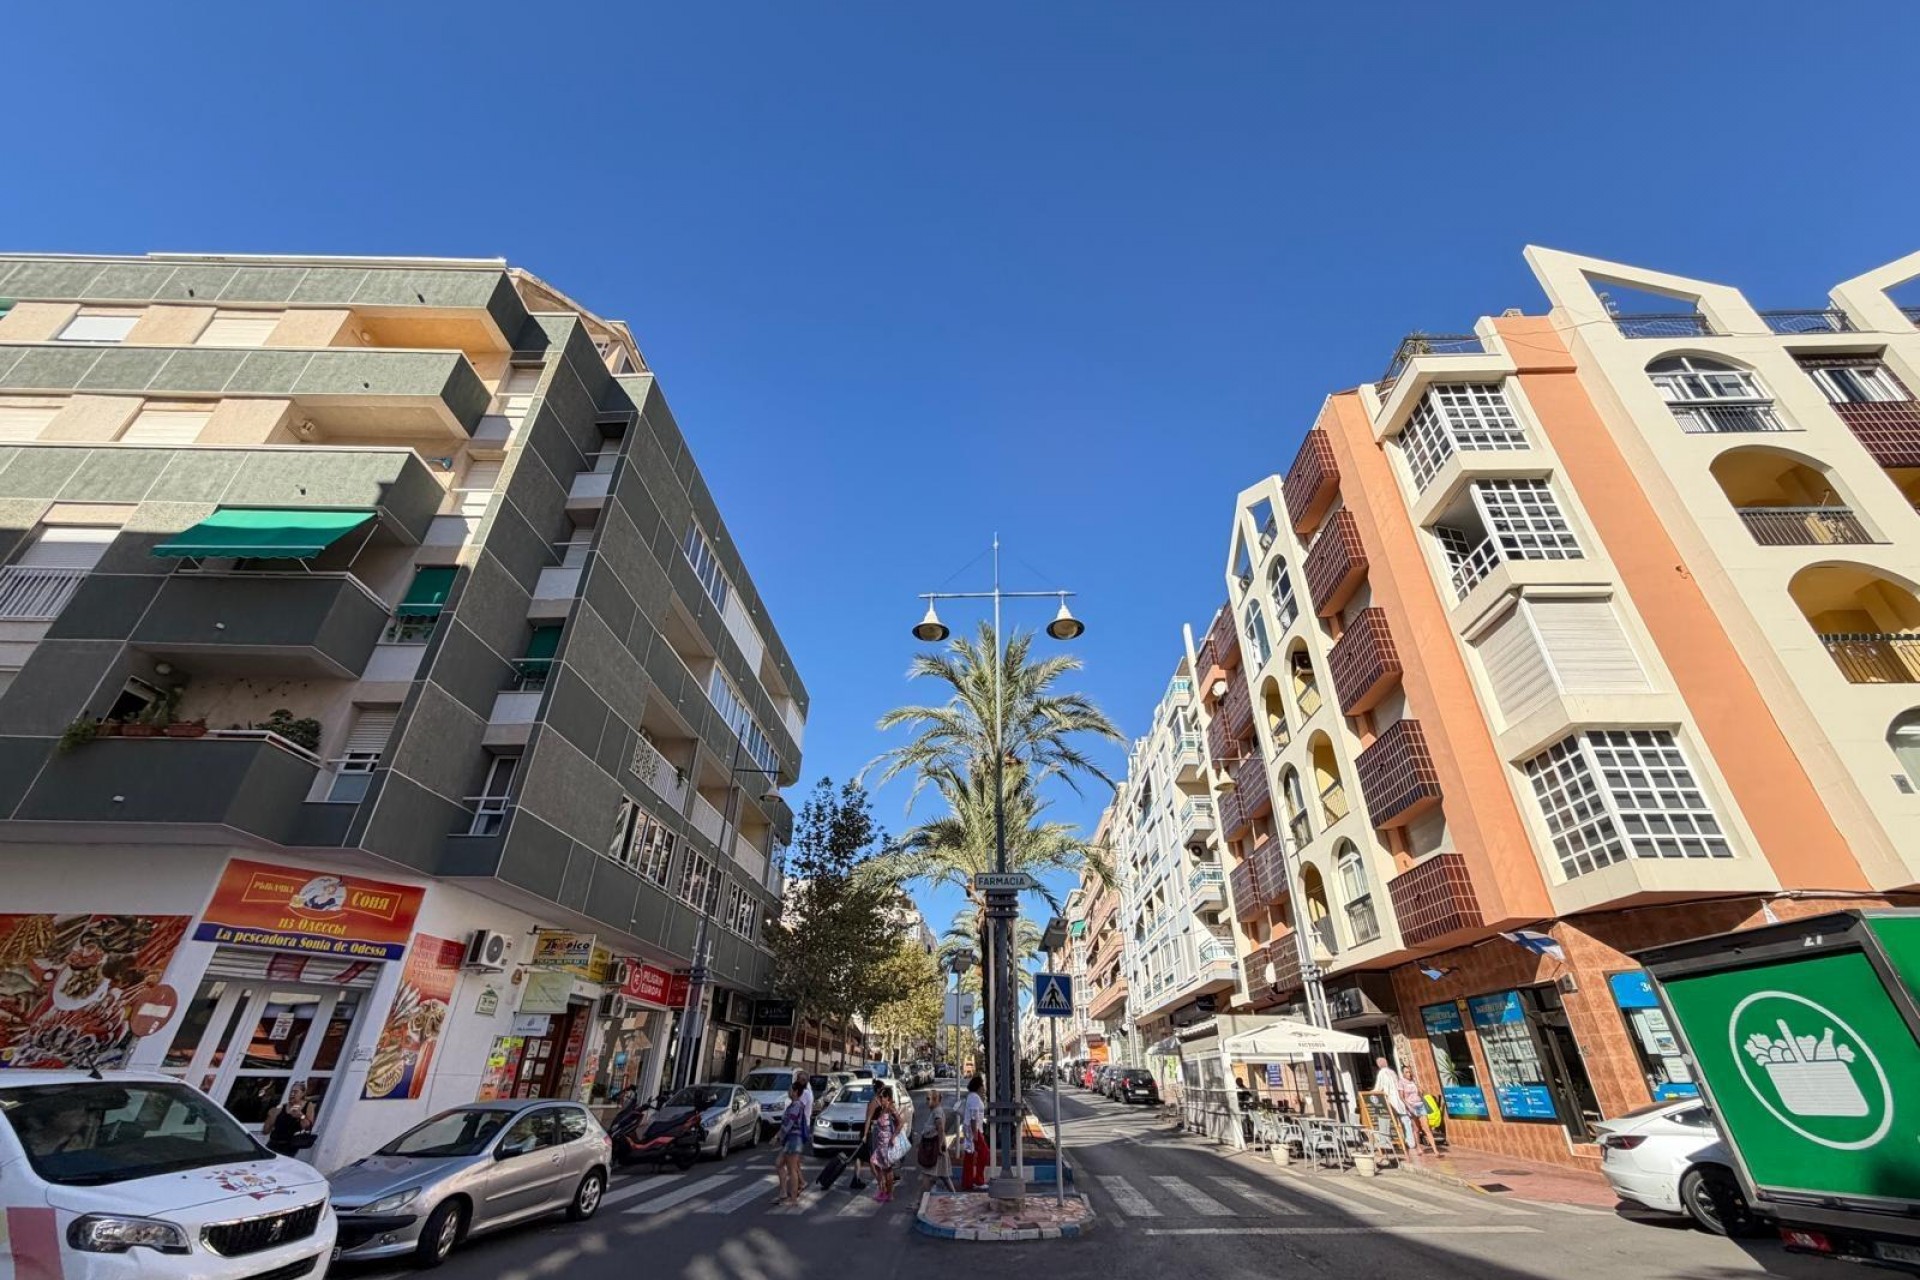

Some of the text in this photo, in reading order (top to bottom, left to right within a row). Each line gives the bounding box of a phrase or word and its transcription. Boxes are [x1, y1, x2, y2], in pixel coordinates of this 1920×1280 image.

[978, 877, 1025, 886] FARMACIA
[215, 928, 387, 957] La pescadora Sonia de Odessa
[641, 983, 662, 997] EUROPA
